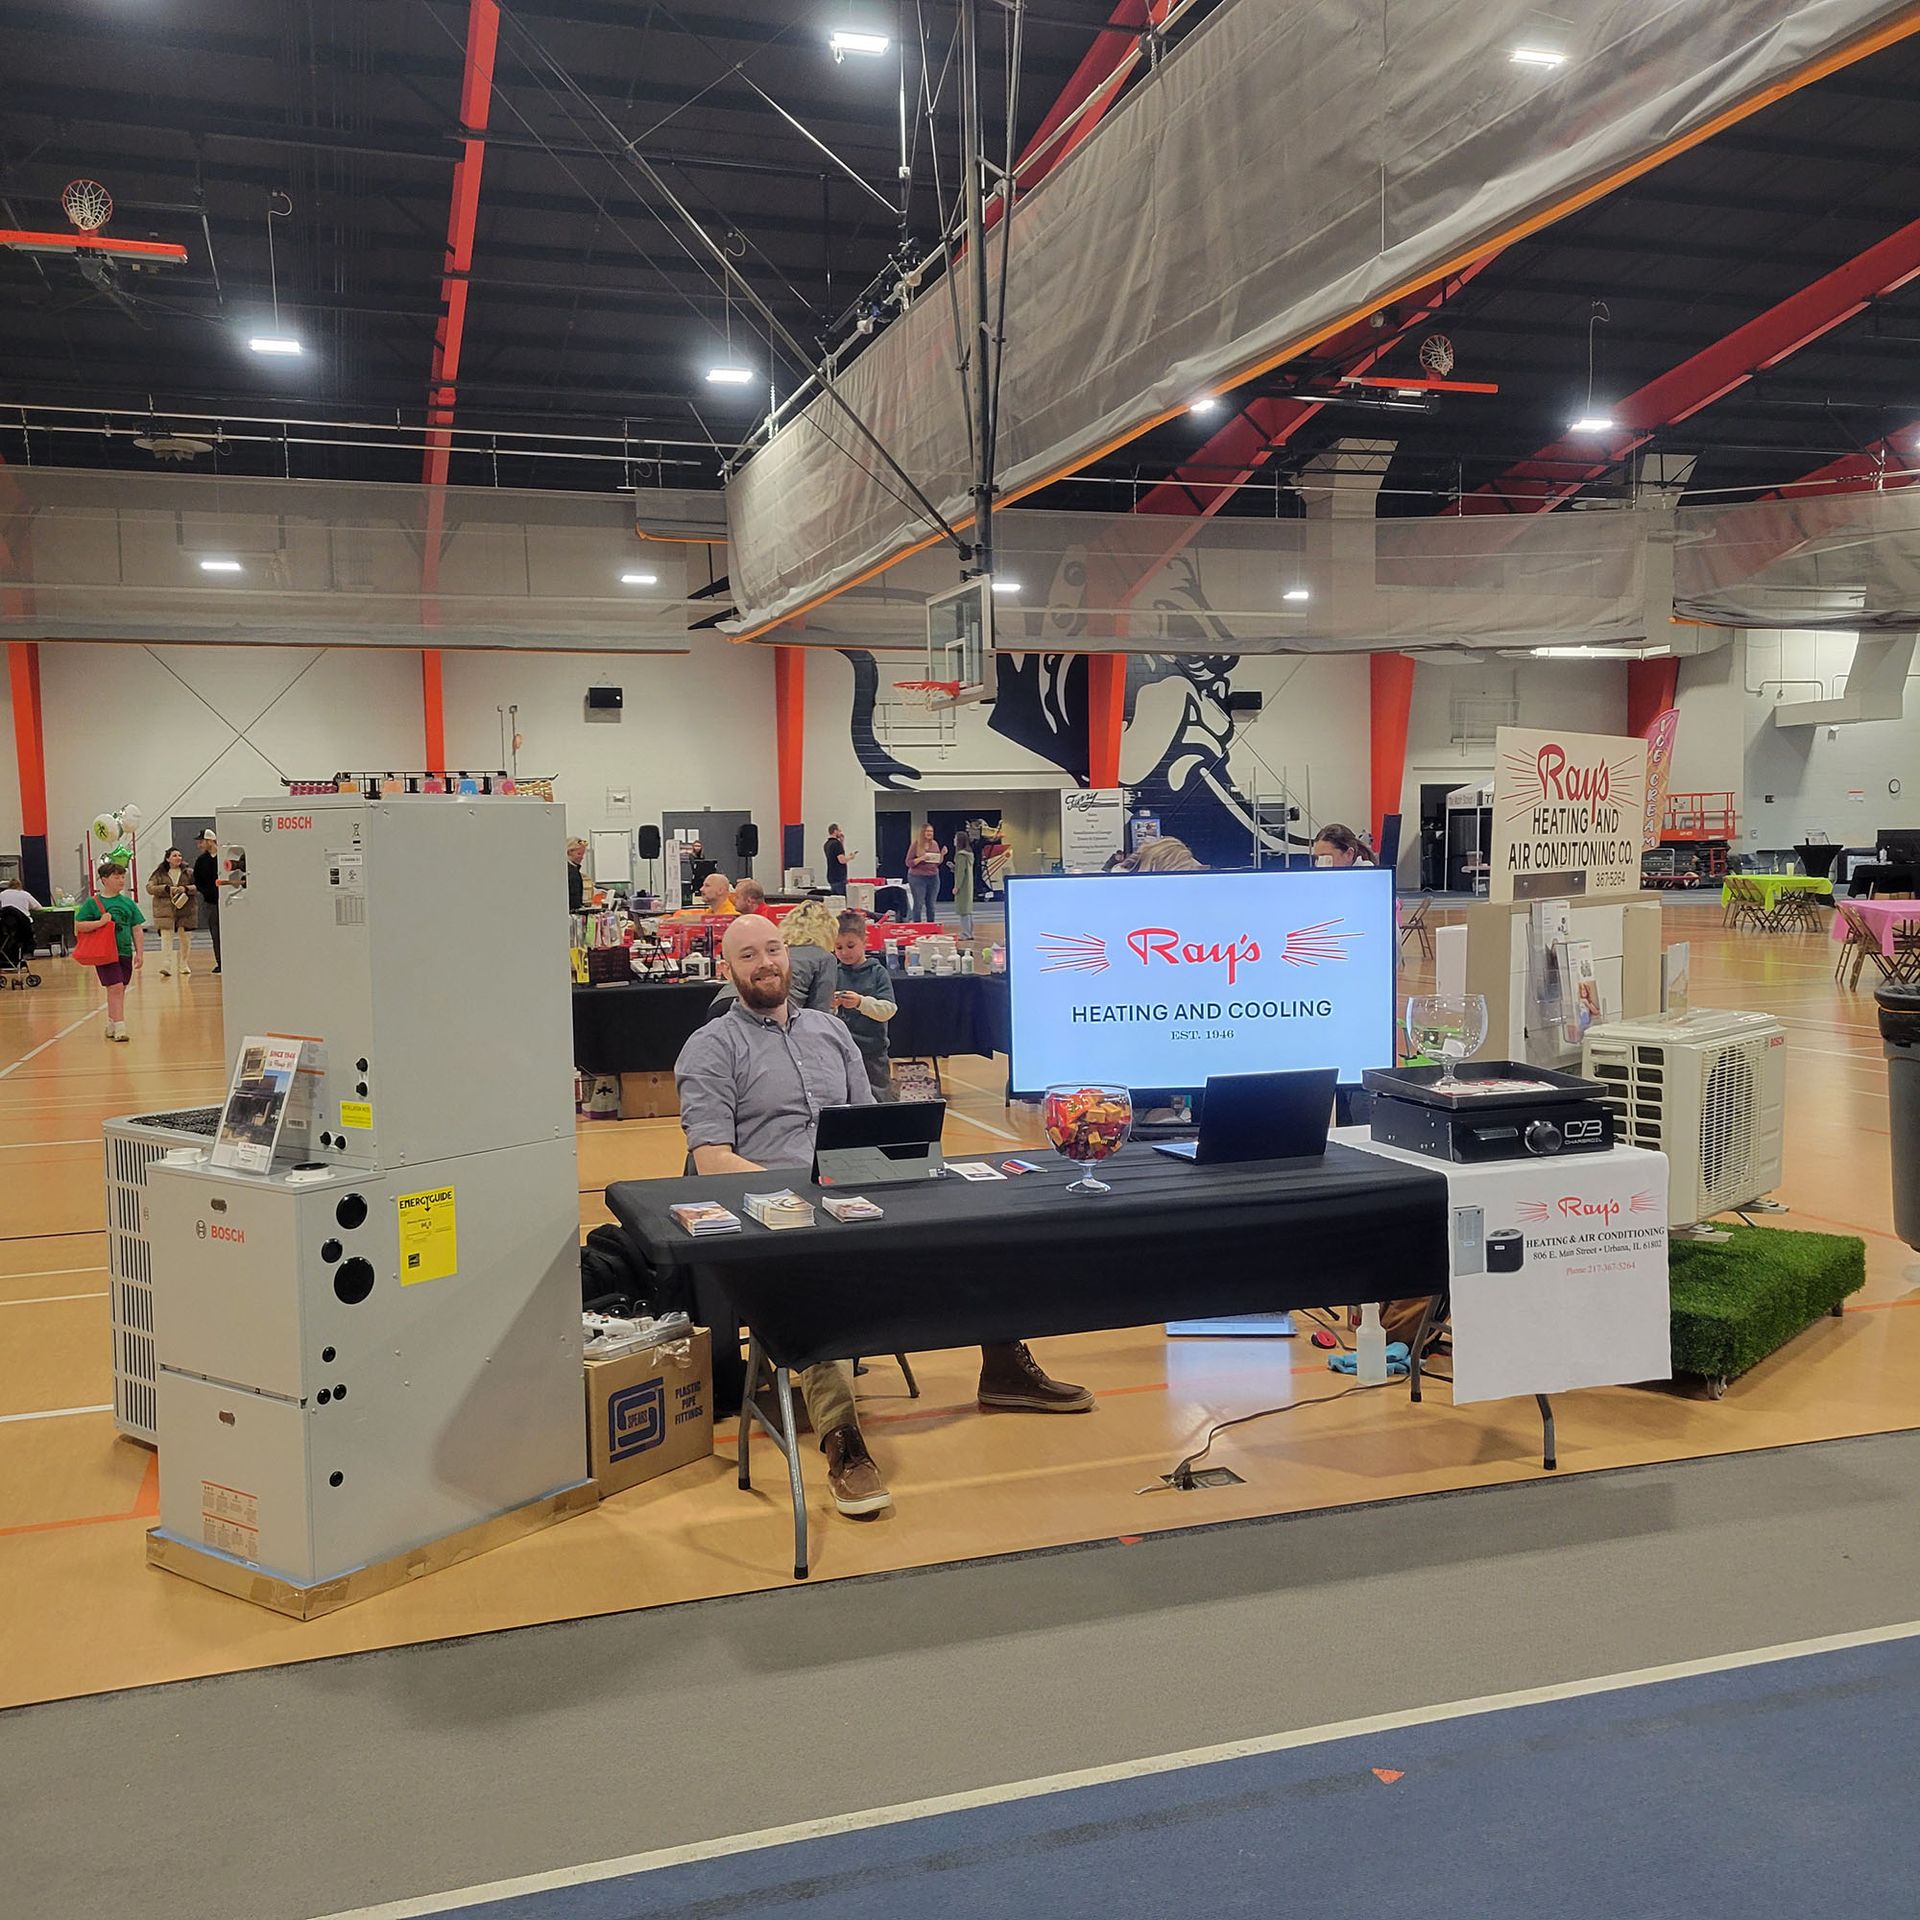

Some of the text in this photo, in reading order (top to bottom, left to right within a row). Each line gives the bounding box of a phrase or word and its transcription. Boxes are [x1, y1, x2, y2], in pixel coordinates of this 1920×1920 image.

[1537, 743, 1610, 825] Ray's
[1642, 718, 1667, 848] ICE CREAM
[277, 816, 313, 830] BOSCH
[1532, 807, 1620, 835] HEATING AND
[1507, 840, 1634, 870] AIR CONDITIONING CO.
[1126, 927, 1262, 986] Ray's
[1071, 999, 1333, 1024] HEATING AND COOLING
[1170, 1028, 1235, 1041] EST. 1946
[1564, 1119, 1603, 1138] CB
[1557, 1196, 1621, 1227] Ray's
[211, 1225, 245, 1244] BOSCH
[1526, 1226, 1665, 1249] HEATING & AIR CONDITIONING
[1533, 1251, 1547, 1260] 806
[1549, 1250, 1557, 1259] E.
[1576, 1247, 1597, 1256] Street
[1604, 1243, 1631, 1254] Urbana,
[1633, 1241, 1642, 1251] IL
[675, 1381, 701, 1399] PLASTIC
[681, 1396, 696, 1410] PIPE
[675, 1405, 703, 1425] FITTINGS
